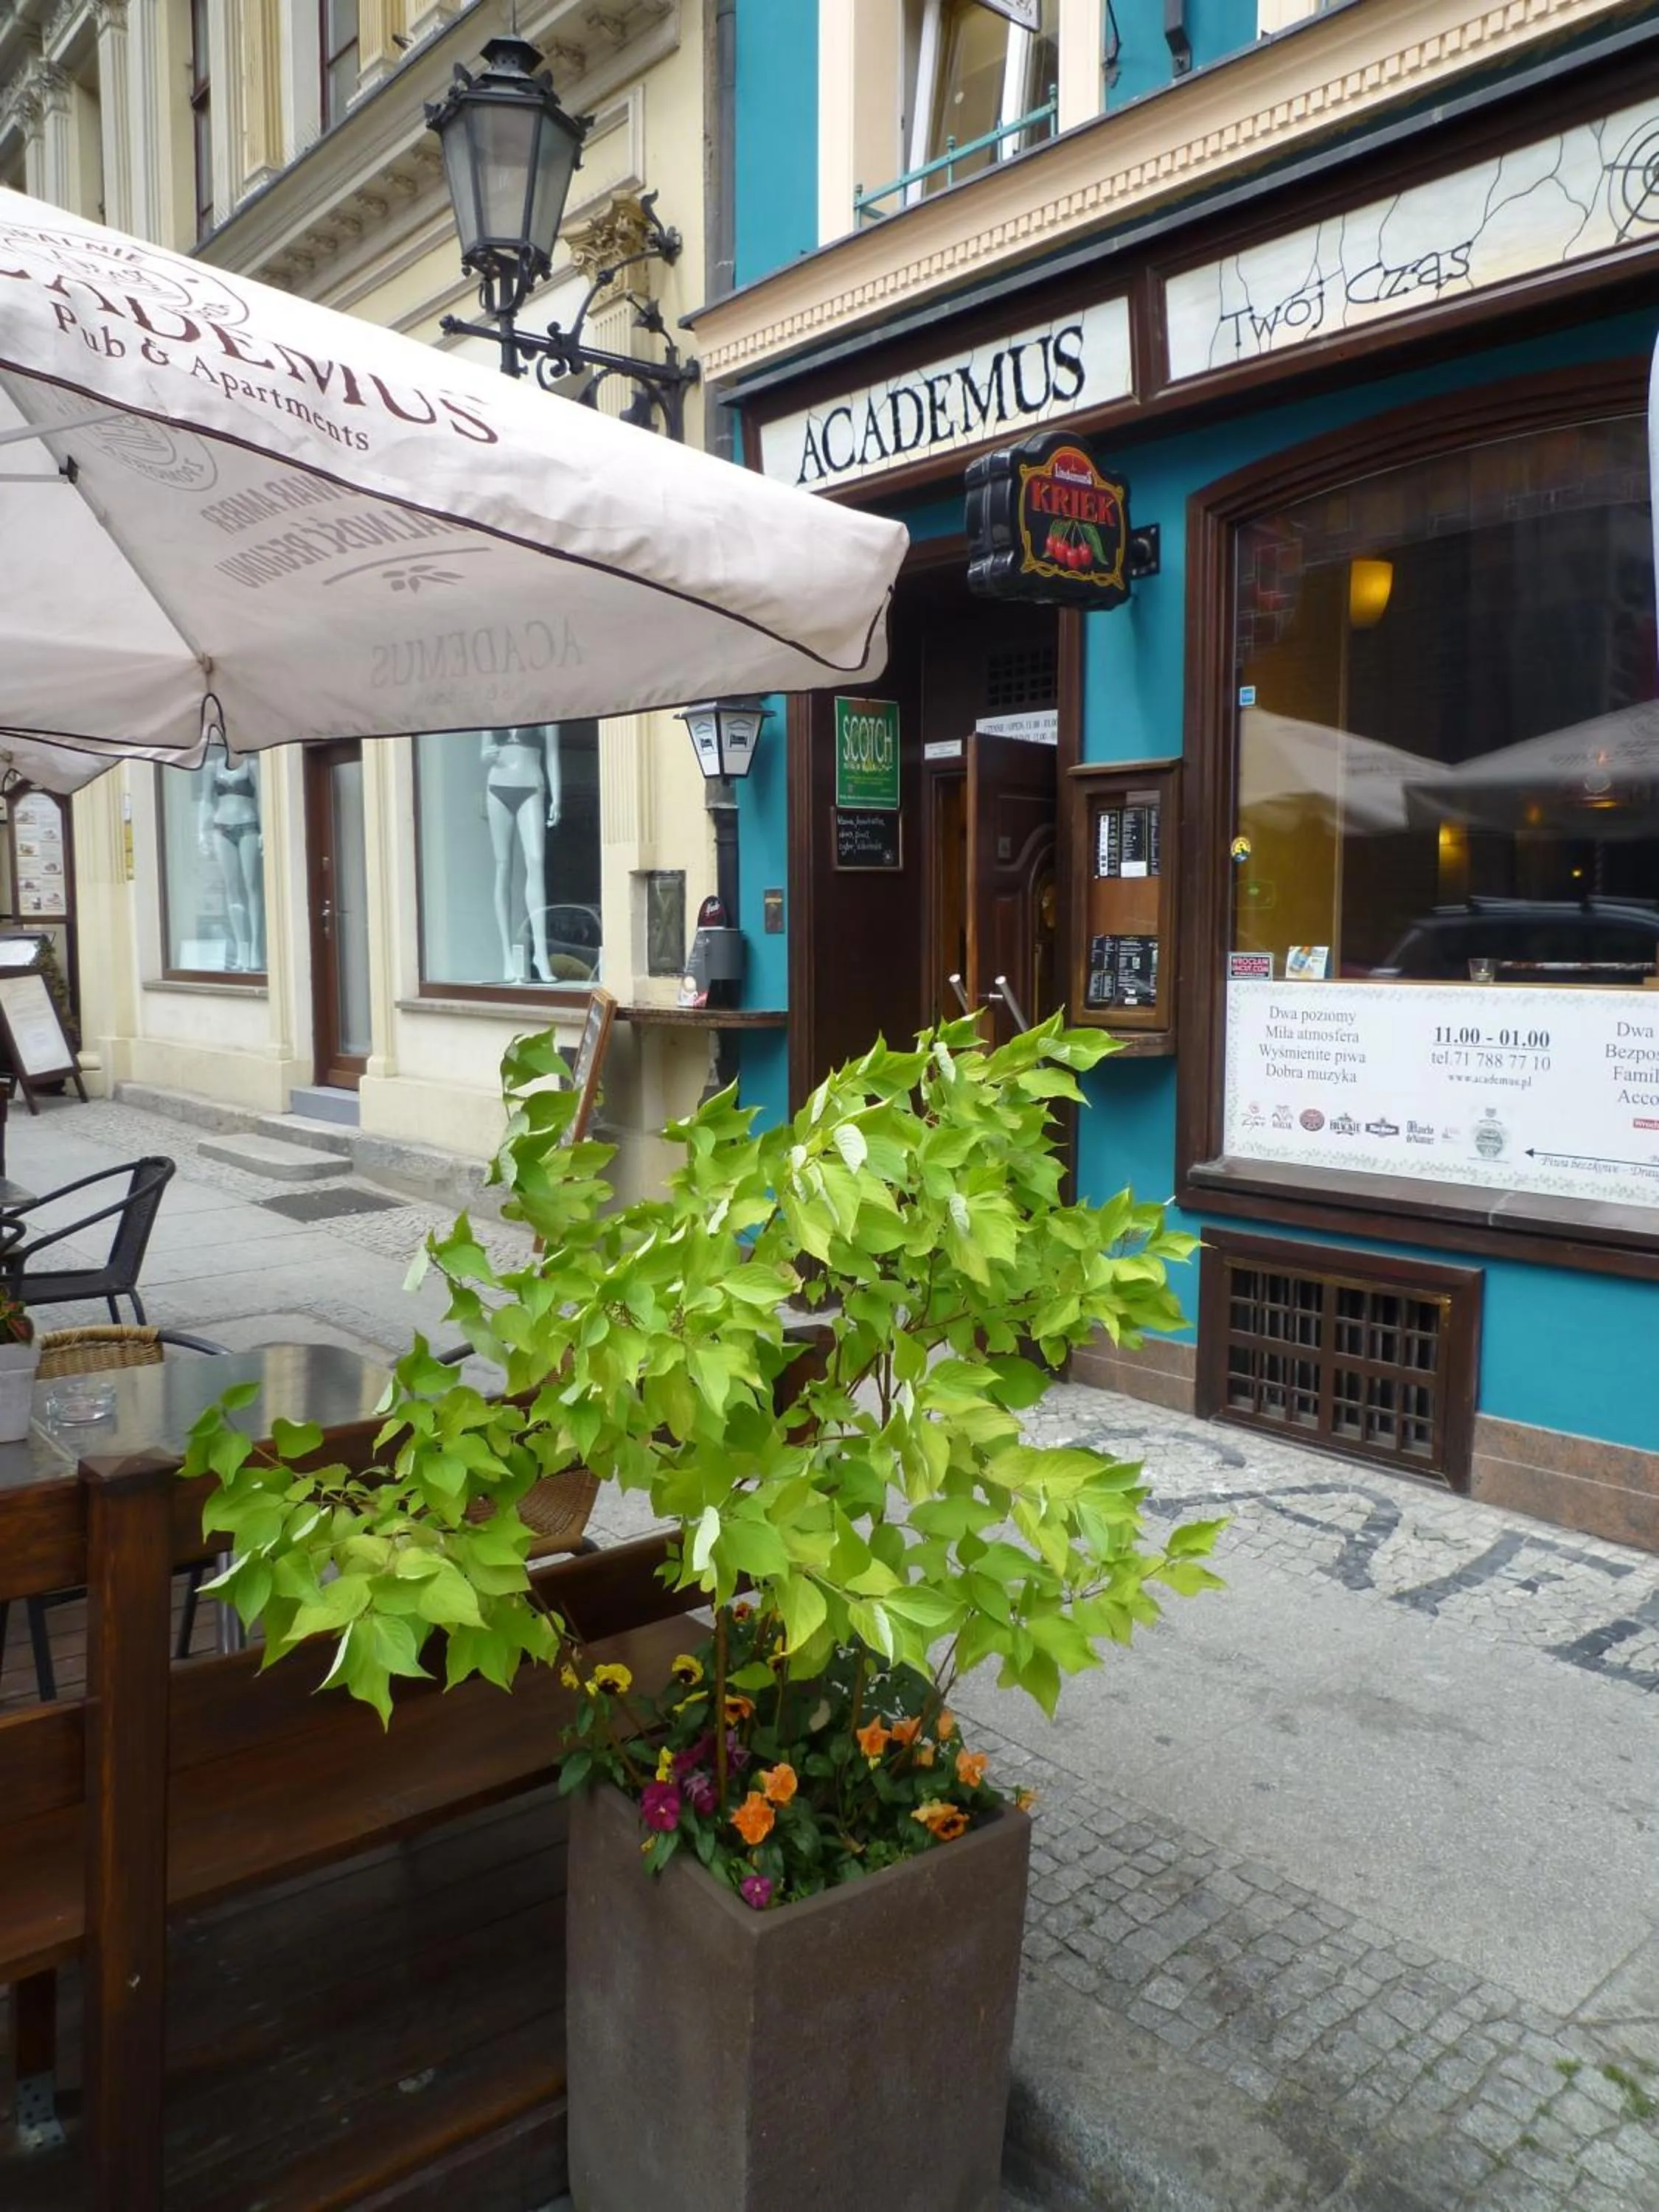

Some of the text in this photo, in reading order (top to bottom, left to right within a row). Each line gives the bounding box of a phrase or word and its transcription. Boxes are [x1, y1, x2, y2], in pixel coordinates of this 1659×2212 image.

[1346, 241, 1472, 303] Czas
[49, 300, 126, 358] Pub
[141, 337, 170, 366] &
[190, 355, 369, 451] Apartments
[796, 324, 1086, 485] ACADEMUS
[1032, 480, 1116, 527] KRIEK
[843, 714, 893, 763] SCOTCH
[1270, 1006, 1356, 1025] Dwa poziomy
[1297, 1026, 1360, 1043] atmosfera
[1435, 1026, 1481, 1045] 11.00
[1499, 1029, 1550, 1048] 01.00
[1617, 1021, 1655, 1038] Dwa
[1335, 1051, 1366, 1065] piwa
[1476, 1053, 1503, 1068] 788
[1509, 1054, 1527, 1071] 77
[1534, 1056, 1551, 1071] 10
[1265, 1062, 1357, 1085] Dobra muzyka
